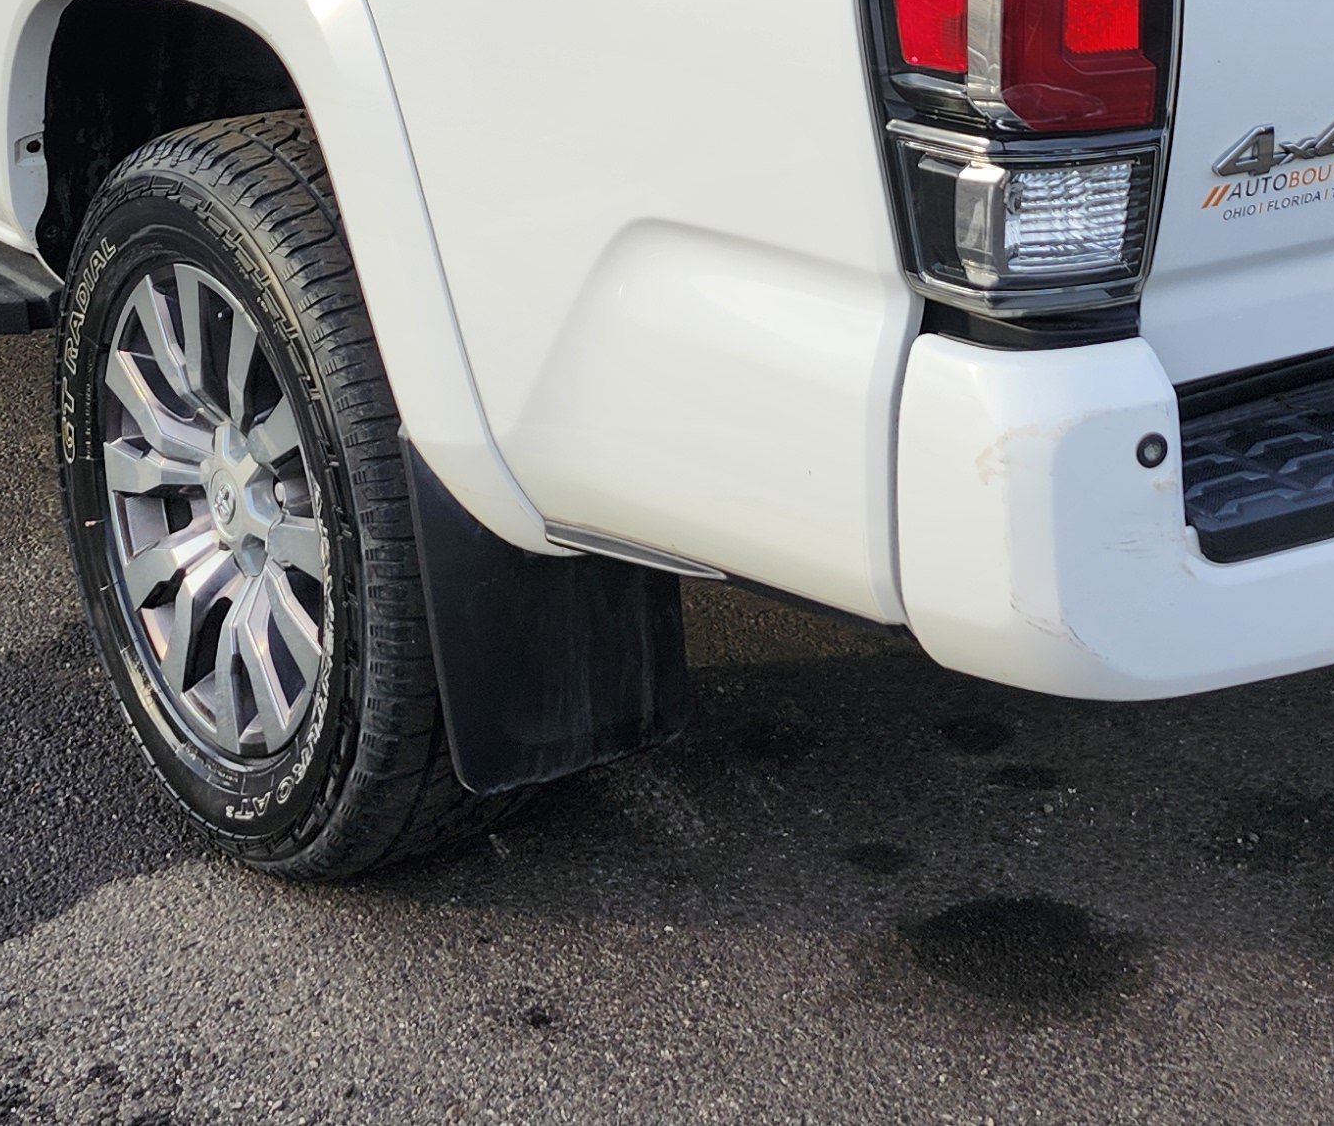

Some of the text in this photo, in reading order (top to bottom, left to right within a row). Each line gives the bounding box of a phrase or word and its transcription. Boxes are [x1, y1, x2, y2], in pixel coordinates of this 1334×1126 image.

[1222, 203, 1257, 221] OHIO
[1266, 189, 1322, 212] FLORIDA
[64, 236, 118, 375] RADIAL
